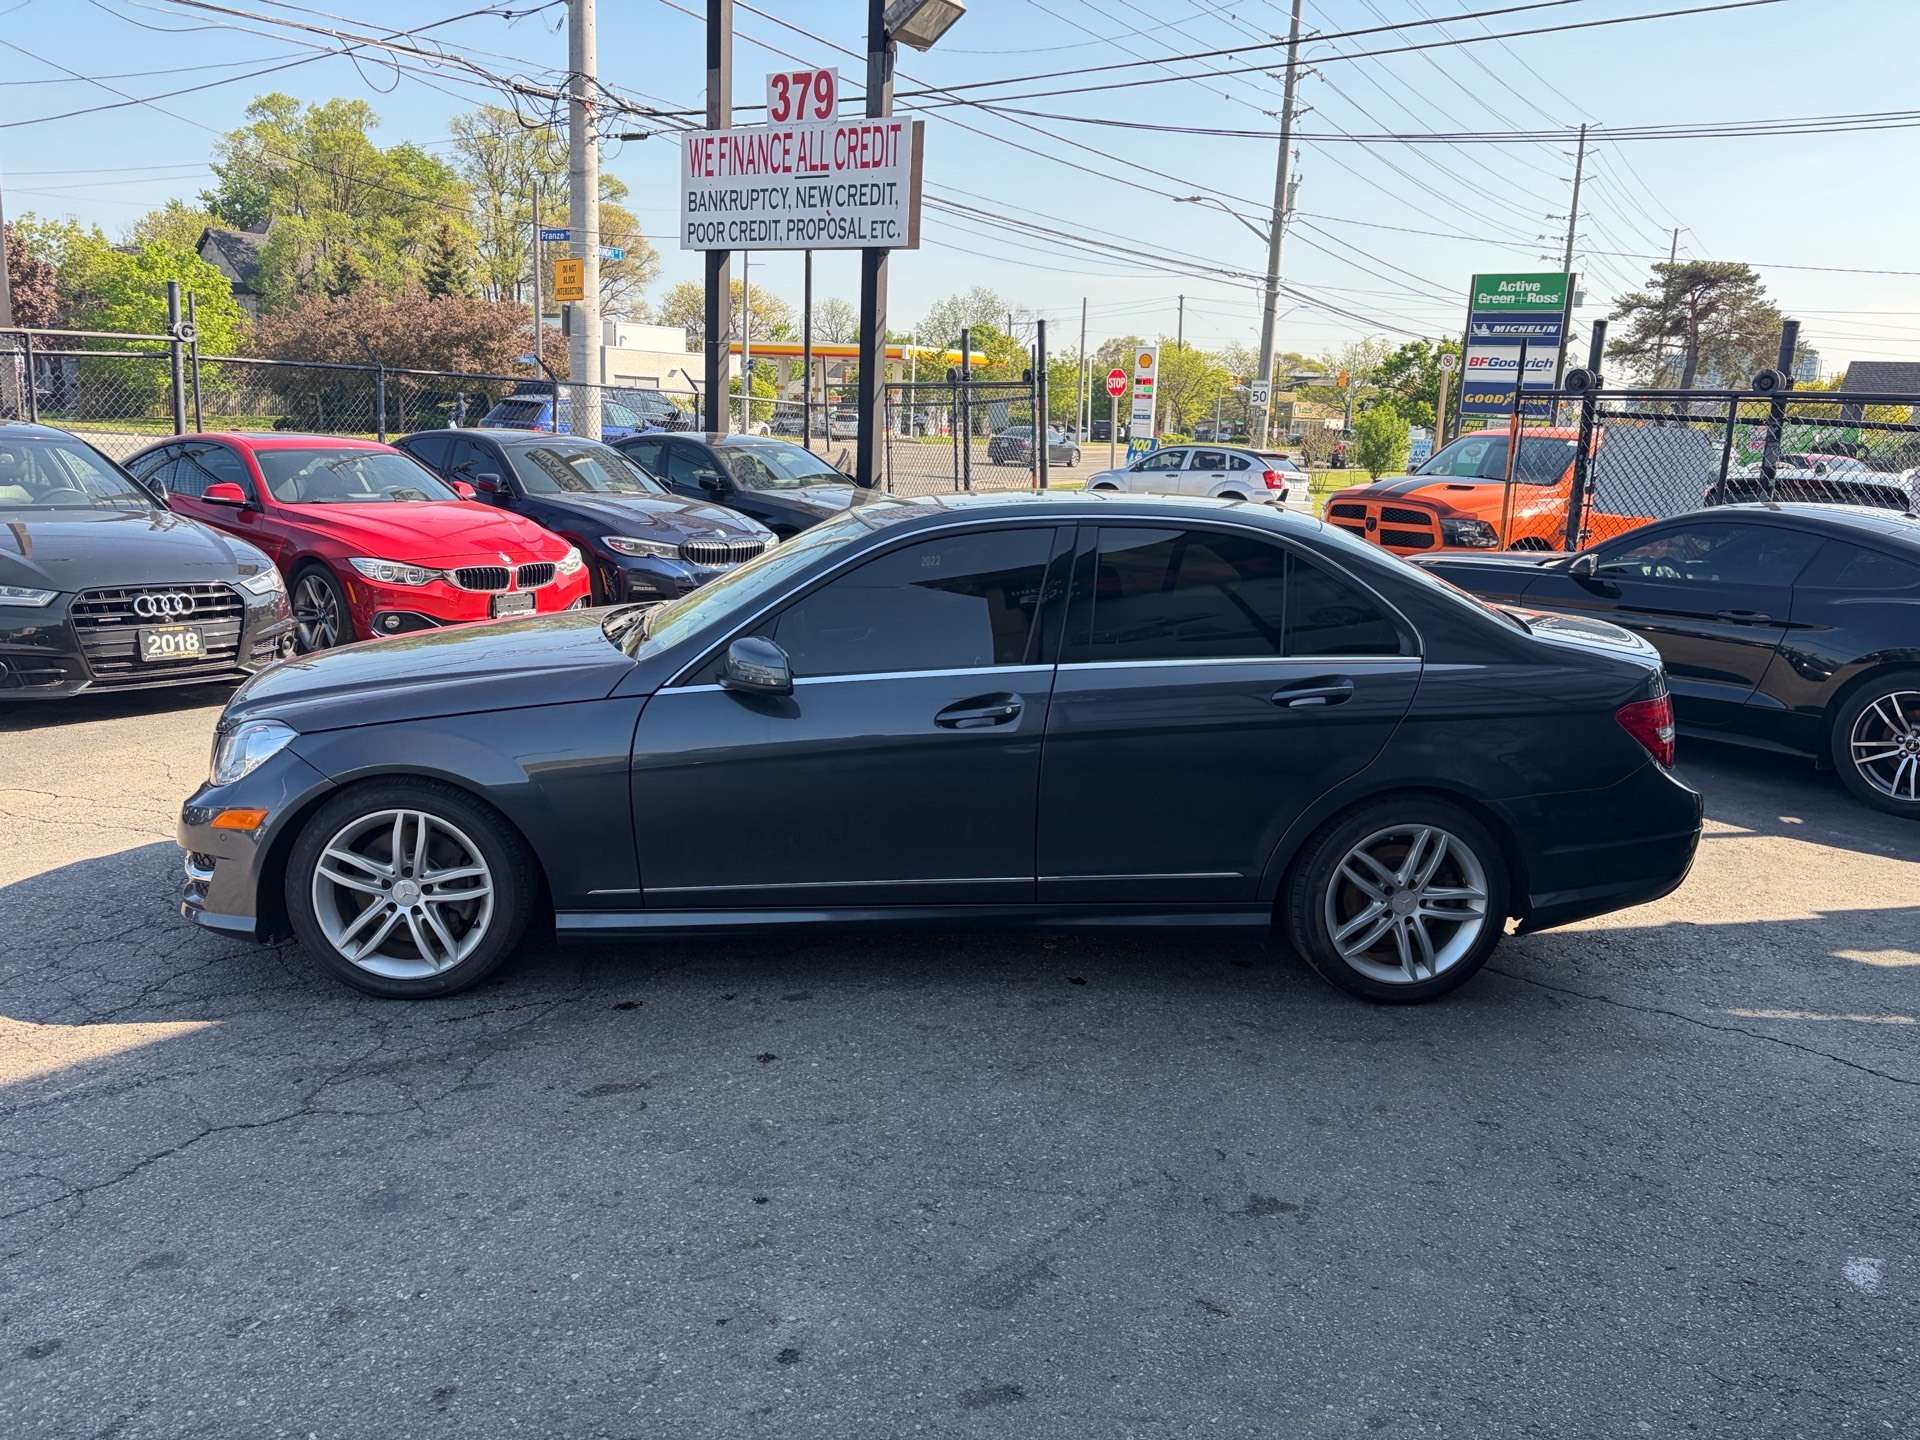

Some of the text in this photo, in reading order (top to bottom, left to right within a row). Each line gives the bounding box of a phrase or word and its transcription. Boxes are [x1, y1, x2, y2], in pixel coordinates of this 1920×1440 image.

[770, 70, 834, 122] 379
[689, 124, 902, 177] WE FINANCE ALL CREDIT
[688, 182, 899, 213] BANKRUPTCY, NEW CREDIT,
[541, 231, 564, 240] Franze
[687, 217, 901, 244] POOR CREDIT, PROPOSAL ETC.
[562, 276, 577, 284] BLOCK
[1498, 281, 1541, 292] Active
[1492, 325, 1558, 333] MICHELIN
[1468, 356, 1554, 369] BFGoorich
[1108, 377, 1126, 388] STOP
[1252, 390, 1267, 402] 50
[148, 632, 199, 653] 2018
